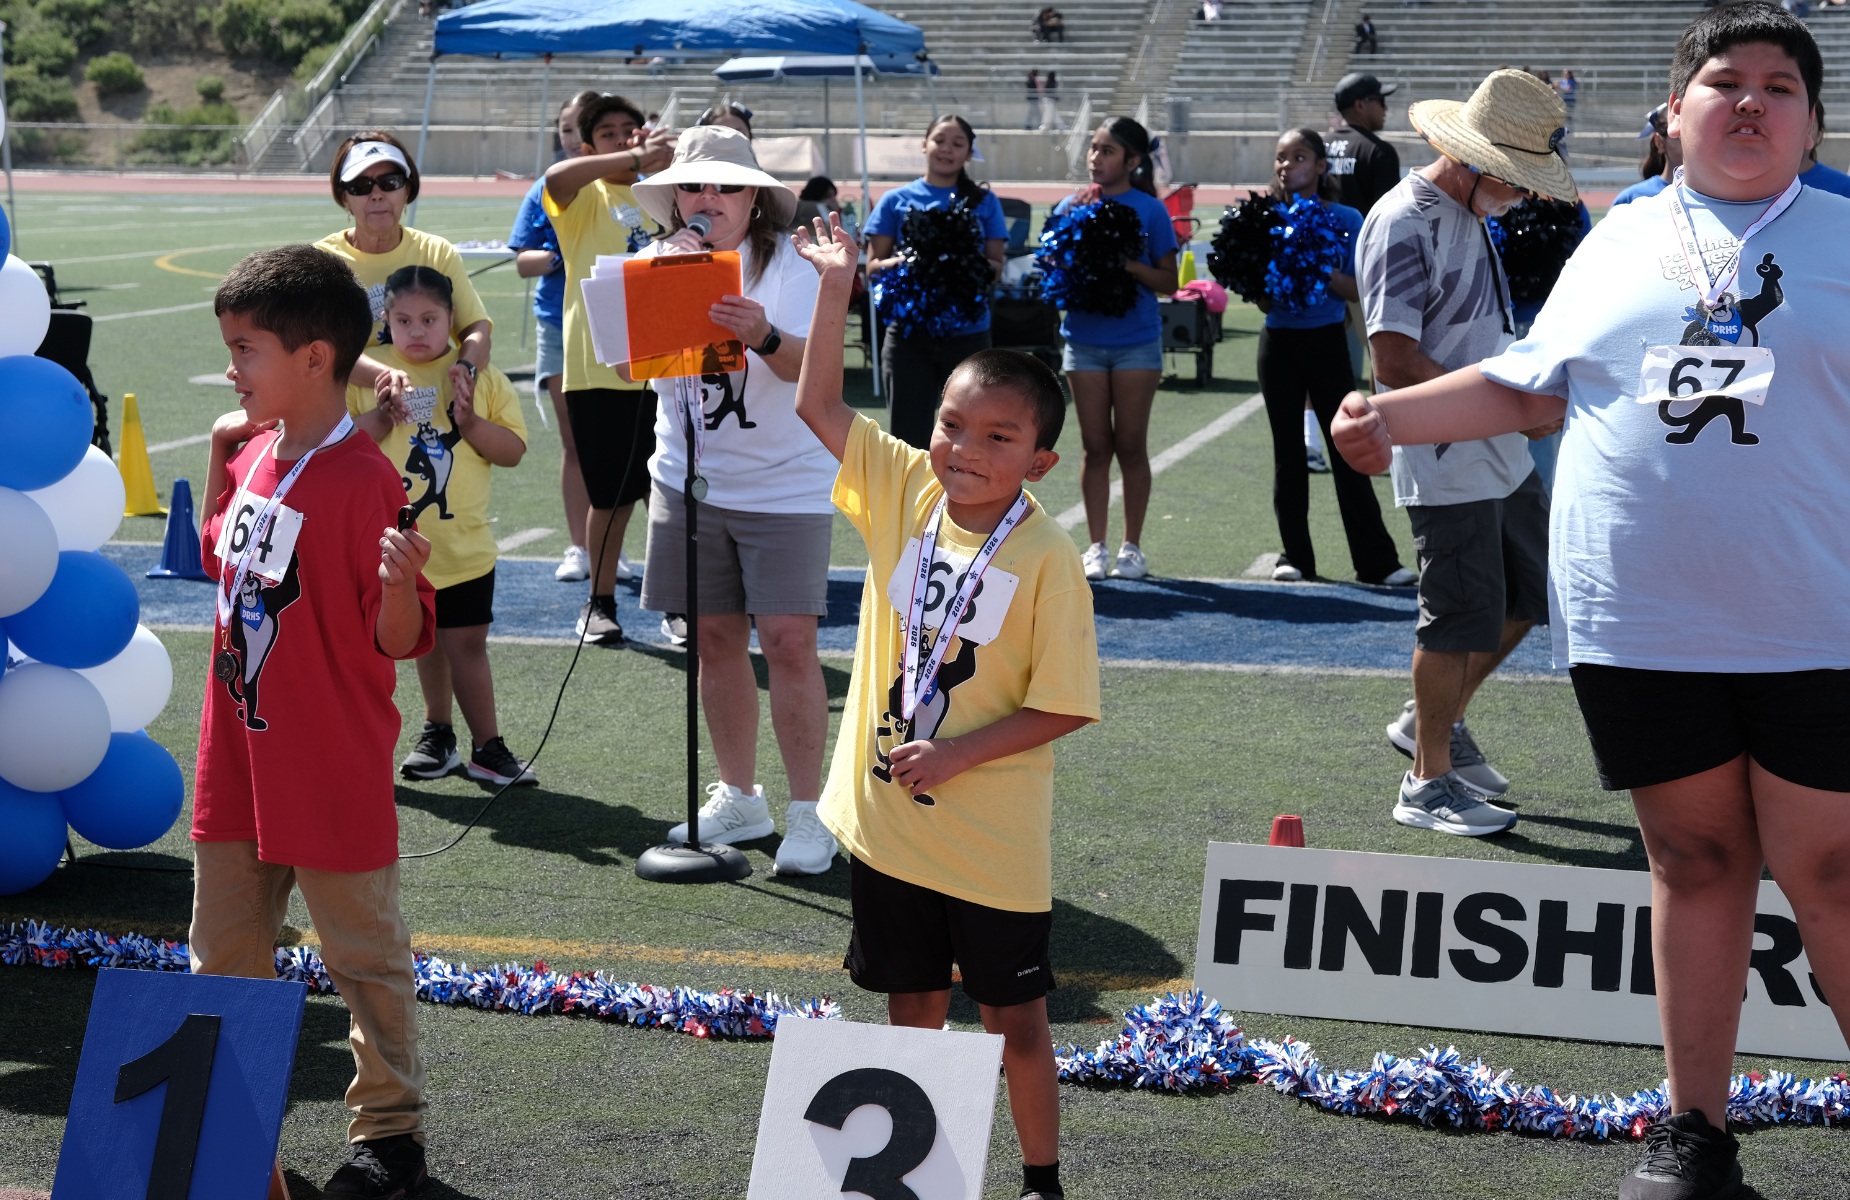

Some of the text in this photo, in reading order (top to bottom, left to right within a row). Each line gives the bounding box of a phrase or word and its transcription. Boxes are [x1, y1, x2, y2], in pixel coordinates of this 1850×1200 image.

[1712, 324, 1739, 335] DRHS
[1668, 357, 1746, 399] 67
[404, 397, 437, 412] ames
[291, 459, 306, 477] 2026
[230, 504, 278, 563] 64
[256, 513, 269, 533] 2026
[983, 536, 999, 557] 2026
[920, 557, 929, 580] 2026
[926, 561, 984, 625] 68
[241, 608, 261, 621] DRHS
[951, 595, 965, 618] 2026
[910, 625, 919, 648] 2026
[924, 658, 937, 680] 2026
[1213, 879, 1830, 1007] FINISHR
[114, 1014, 222, 1200] 1
[804, 1068, 937, 1200] 3
